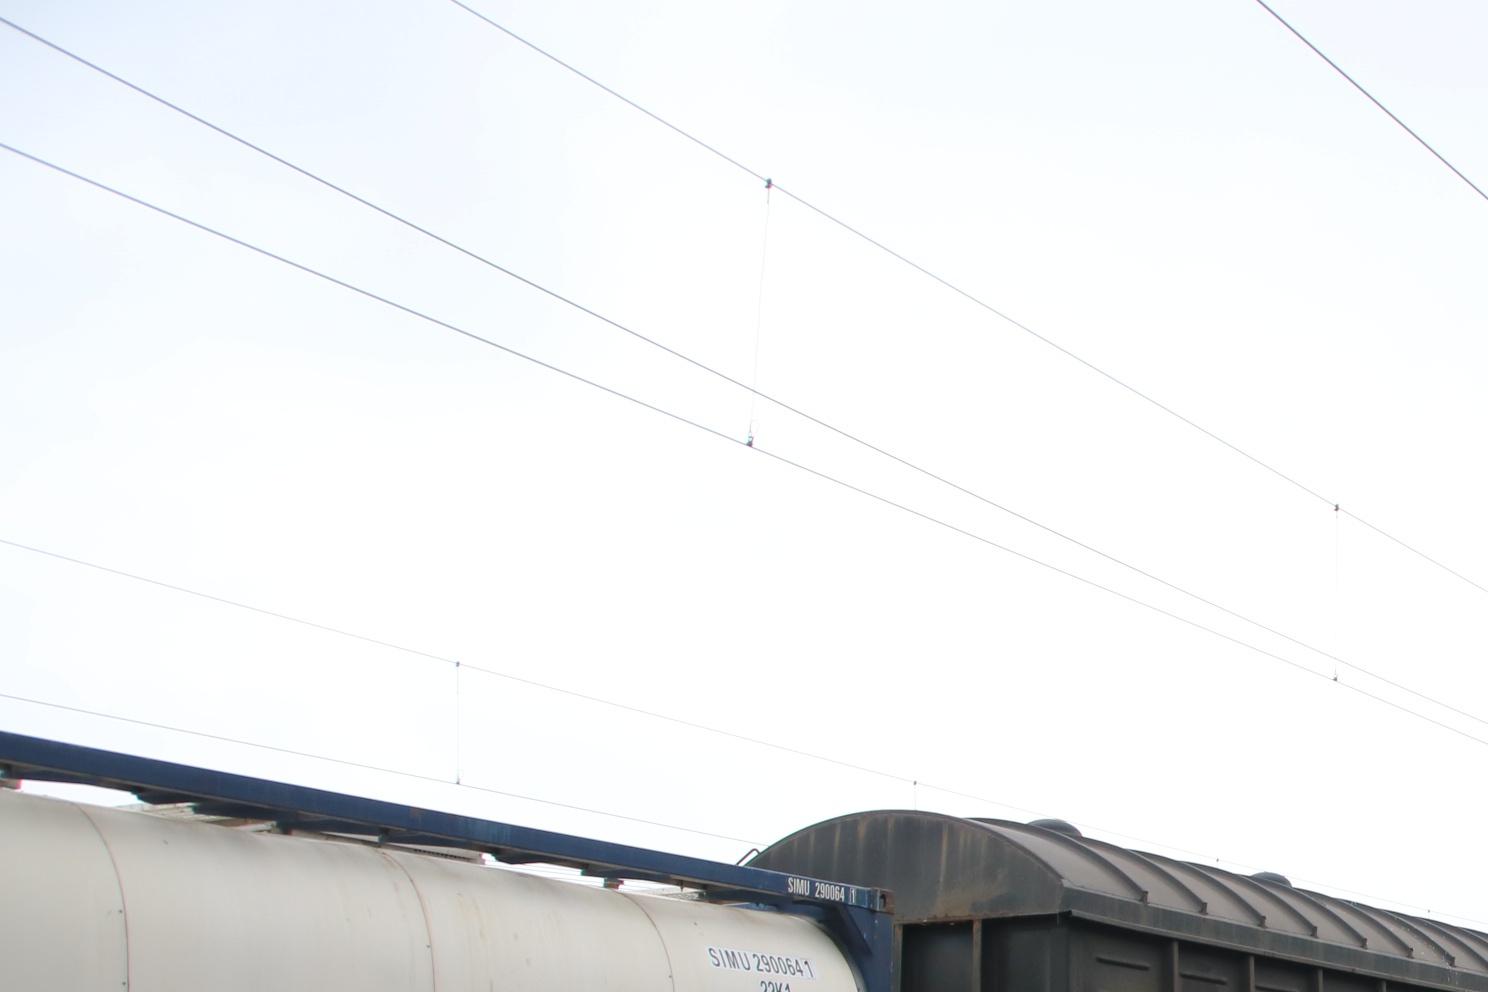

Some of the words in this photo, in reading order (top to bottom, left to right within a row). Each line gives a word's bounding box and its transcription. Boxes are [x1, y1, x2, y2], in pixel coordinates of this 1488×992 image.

[788, 877, 810, 895] SIMU
[815, 882, 845, 900] 290064
[708, 947, 751, 972] SIMU
